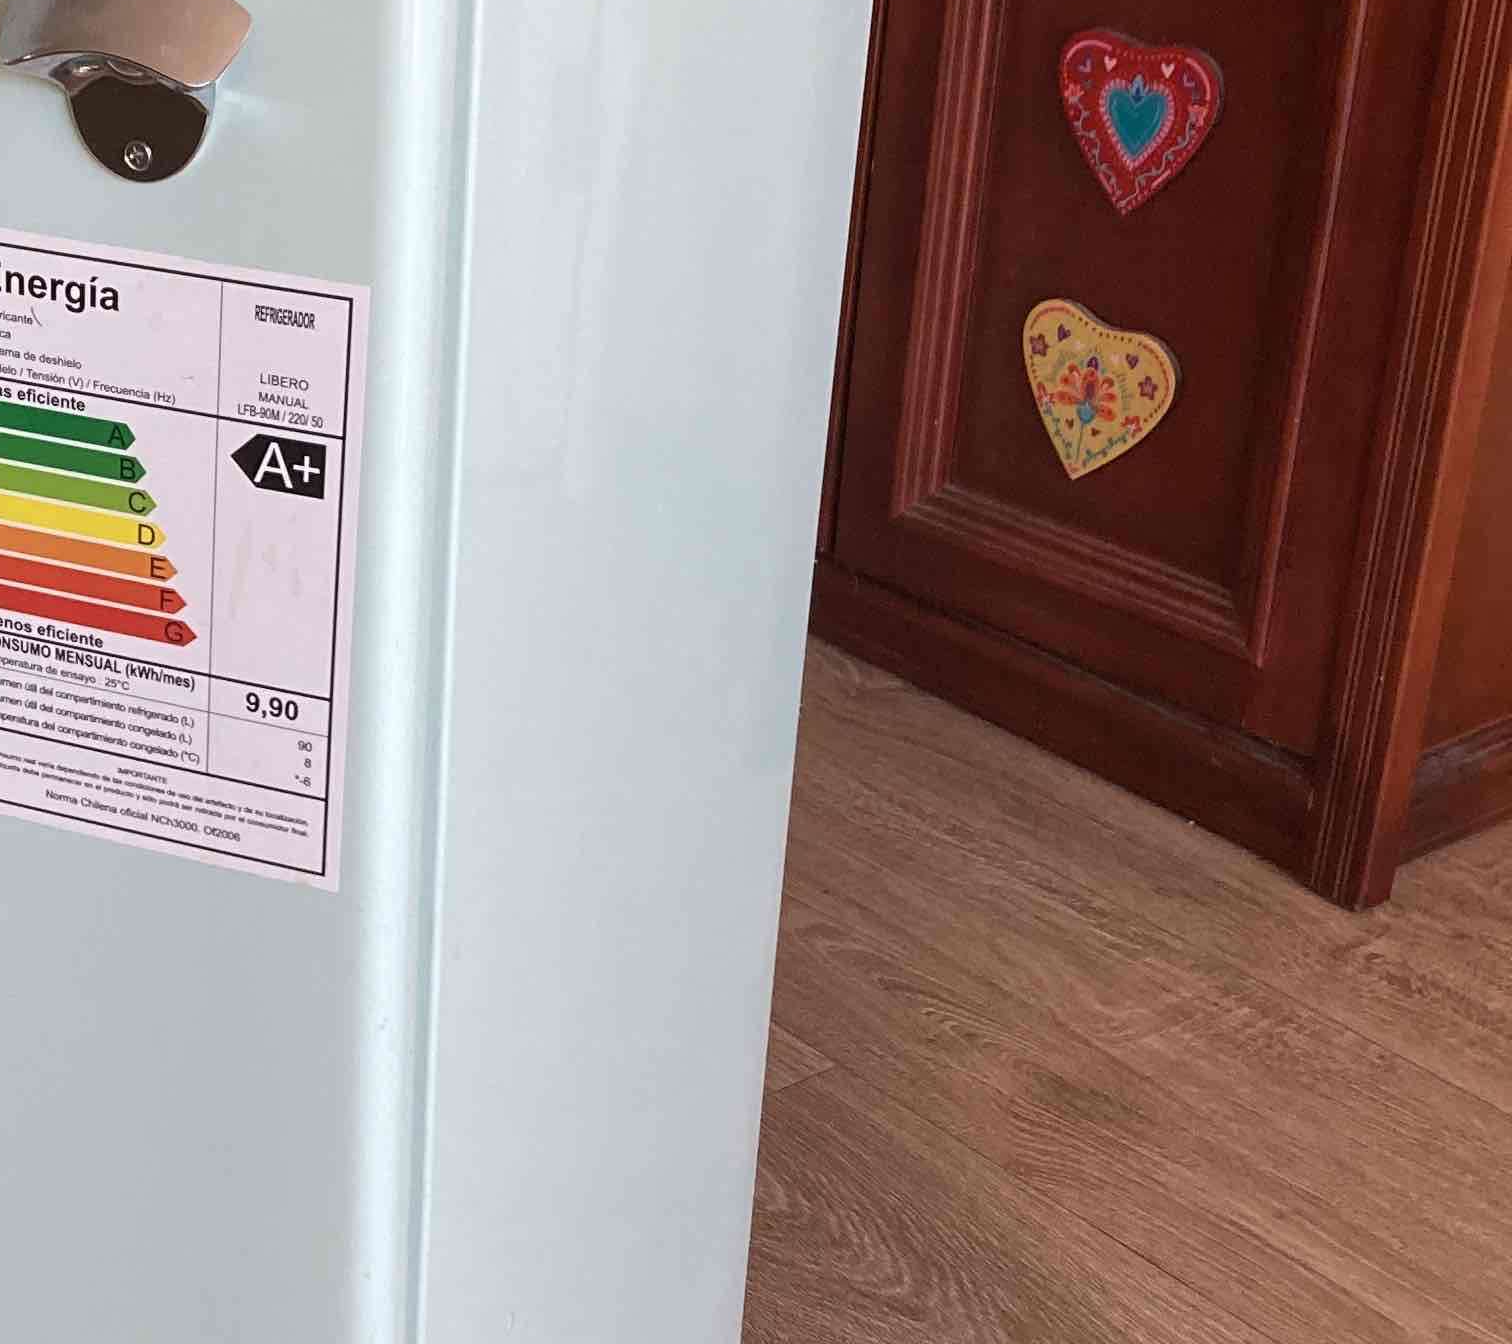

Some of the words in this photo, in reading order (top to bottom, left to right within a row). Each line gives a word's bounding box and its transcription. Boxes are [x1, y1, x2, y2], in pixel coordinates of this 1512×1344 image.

[255, 305, 314, 329] REFRIGERADOR
[24, 352, 36, 361] de
[39, 354, 81, 369] deshielo
[27, 368, 65, 384] Tensión
[69, 376, 84, 389] (V)
[93, 380, 150, 399] Frecuencia
[154, 392, 175, 405] (Hz)
[260, 373, 309, 391] LIBERO
[17, 389, 85, 411] eficiente
[259, 392, 308, 409] MANUAL
[312, 416, 323, 428] 50
[107, 424, 127, 448] A
[120, 458, 136, 481] B
[253, 441, 321, 490] A+
[128, 491, 147, 514] C
[138, 524, 156, 546] D
[150, 557, 167, 580] E
[160, 590, 175, 611] F
[37, 625, 103, 648] eficiente
[163, 621, 184, 643] G
[46, 666, 57, 675] de
[59, 670, 96, 686] ensayo
[56, 648, 121, 673] MENSUAL
[126, 664, 195, 692] (kWh/mes)
[40, 687, 53, 696] del
[246, 693, 298, 720] 9,90
[297, 740, 313, 753] 90
[303, 758, 312, 769] 8
[46, 789, 78, 804] Norma
[81, 798, 117, 813] Chilena
[120, 808, 148, 820] oficial
